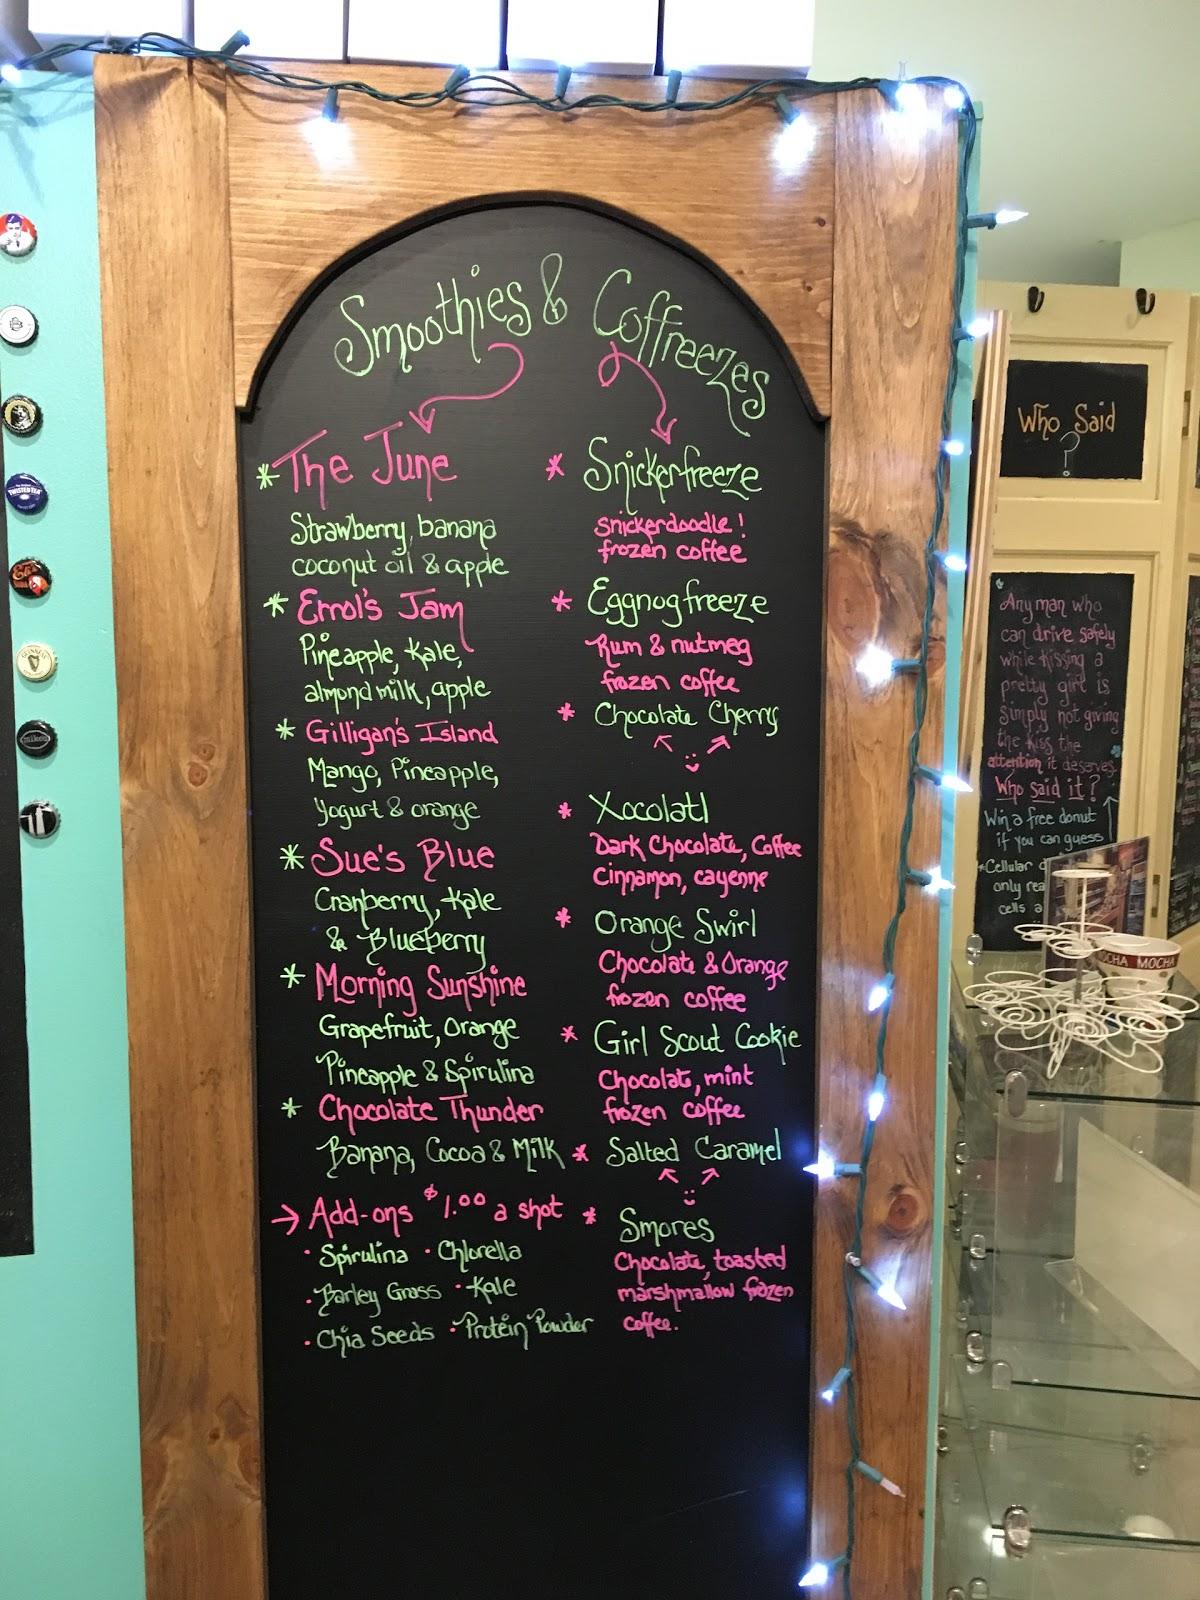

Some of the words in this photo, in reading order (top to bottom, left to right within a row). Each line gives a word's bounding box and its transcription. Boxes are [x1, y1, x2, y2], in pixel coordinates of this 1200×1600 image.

[334, 264, 532, 376] Smoothies
[540, 253, 568, 325] &
[593, 268, 770, 437] Coffreezes
[1018, 403, 1061, 441] Who
[1074, 401, 1116, 434] Said
[272, 430, 354, 510] The
[364, 421, 458, 501] June
[1060, 431, 1081, 477] ?
[584, 436, 762, 515] Snickerfreeze
[290, 512, 414, 556] Strawberry,
[417, 514, 497, 550] banana
[598, 540, 667, 563] frozen
[676, 538, 747, 563] coffee
[292, 550, 377, 587] coconut
[385, 551, 413, 574] oil
[422, 553, 440, 574] &
[444, 553, 509, 587] apple
[297, 588, 383, 625] Errol's
[399, 588, 474, 653] Jam
[1000, 592, 1033, 624] Any
[1035, 598, 1067, 618] man
[1072, 594, 1103, 620] who
[585, 634, 642, 668] Rum
[650, 634, 665, 656] &
[671, 632, 753, 666] nutmeg
[1000, 629, 1030, 649] can
[1032, 623, 1074, 642] drive
[1079, 623, 1115, 649] safely
[299, 632, 399, 681] Pineapple,
[1000, 650, 1035, 675] while
[304, 680, 372, 715] almond
[376, 679, 431, 710] milk,
[431, 676, 491, 714] apple
[601, 671, 670, 693] frozen
[680, 668, 740, 696] coffee
[1001, 676, 1048, 705] pretty
[1097, 672, 1110, 695] is
[594, 702, 697, 739] Chocolate
[708, 700, 779, 736] Cherry
[1058, 704, 1080, 728] not
[306, 717, 410, 755] Gilligan's
[415, 720, 498, 744] Island
[307, 757, 381, 793] Mango,
[390, 757, 499, 788] Pineapple,
[987, 752, 1043, 774] attention
[1047, 756, 1057, 769] it
[995, 769, 1024, 805] Who
[387, 796, 403, 817] &
[411, 801, 480, 830] orange
[588, 791, 709, 824] Xocolatl
[984, 808, 1012, 832] Win
[1011, 813, 1023, 826] a
[1026, 806, 1055, 830] free
[1059, 807, 1097, 824] donut
[311, 837, 405, 877] Sue's
[416, 837, 495, 882] Blue
[589, 833, 646, 862] Dark
[649, 832, 748, 862] Chocolate,
[751, 833, 802, 859] Coffee
[996, 832, 1010, 851] if
[1014, 836, 1034, 853] you
[1040, 835, 1060, 844] can
[1064, 833, 1104, 852] guess
[593, 862, 687, 899] Cinnamon,
[693, 869, 768, 898] cayenne
[984, 859, 1033, 873] Cellular
[314, 886, 441, 930] Cranberry,
[993, 879, 1021, 900] only
[998, 902, 1025, 914] cells
[594, 910, 684, 952] Orange
[694, 908, 756, 944] Swirl
[326, 926, 348, 951] &
[356, 927, 486, 975] Blueberry
[1136, 957, 1176, 969] MOCHA
[598, 950, 695, 983] Chocolate
[704, 951, 719, 975] &
[721, 951, 788, 990] Orange
[315, 962, 417, 1017] Morning
[427, 964, 527, 1012] Sunshine
[606, 983, 669, 1008] frozen
[684, 986, 746, 1012] coffee
[319, 1012, 441, 1048] Grapefruit,
[444, 1016, 520, 1050] Orange
[594, 1019, 648, 1056] Girl
[659, 1024, 725, 1057] Scout
[735, 1023, 801, 1065] Cookie
[315, 1050, 419, 1095] Pineapple
[423, 1060, 439, 1082] &
[444, 1052, 535, 1095] Spirulina
[704, 1064, 754, 1087] mint
[319, 1094, 438, 1136] Chocolate
[439, 1093, 544, 1134] Thunder
[602, 1096, 667, 1126] frozen
[682, 1095, 745, 1126] coffee
[315, 1136, 416, 1179] Banana,
[426, 1137, 486, 1163] Cocoa
[489, 1139, 505, 1162] &
[512, 1136, 566, 1173] Milk
[606, 1136, 680, 1167] Salted
[694, 1128, 781, 1165] Caramel
[308, 1197, 413, 1239] Add-ons
[493, 1203, 507, 1221] a
[518, 1194, 563, 1230] shot
[619, 1207, 715, 1247] Smores
[319, 1241, 408, 1275] Spirulina
[437, 1239, 522, 1273] Chlorella
[713, 1245, 786, 1272] toasted
[314, 1283, 382, 1318] Barley
[386, 1282, 442, 1302] Grass
[617, 1282, 735, 1312] marshmallow
[742, 1276, 794, 1302] frozen
[316, 1325, 365, 1358] Chia
[371, 1321, 435, 1344] Seeds
[452, 1311, 529, 1350] Protein
[526, 1307, 594, 1334] Powder
